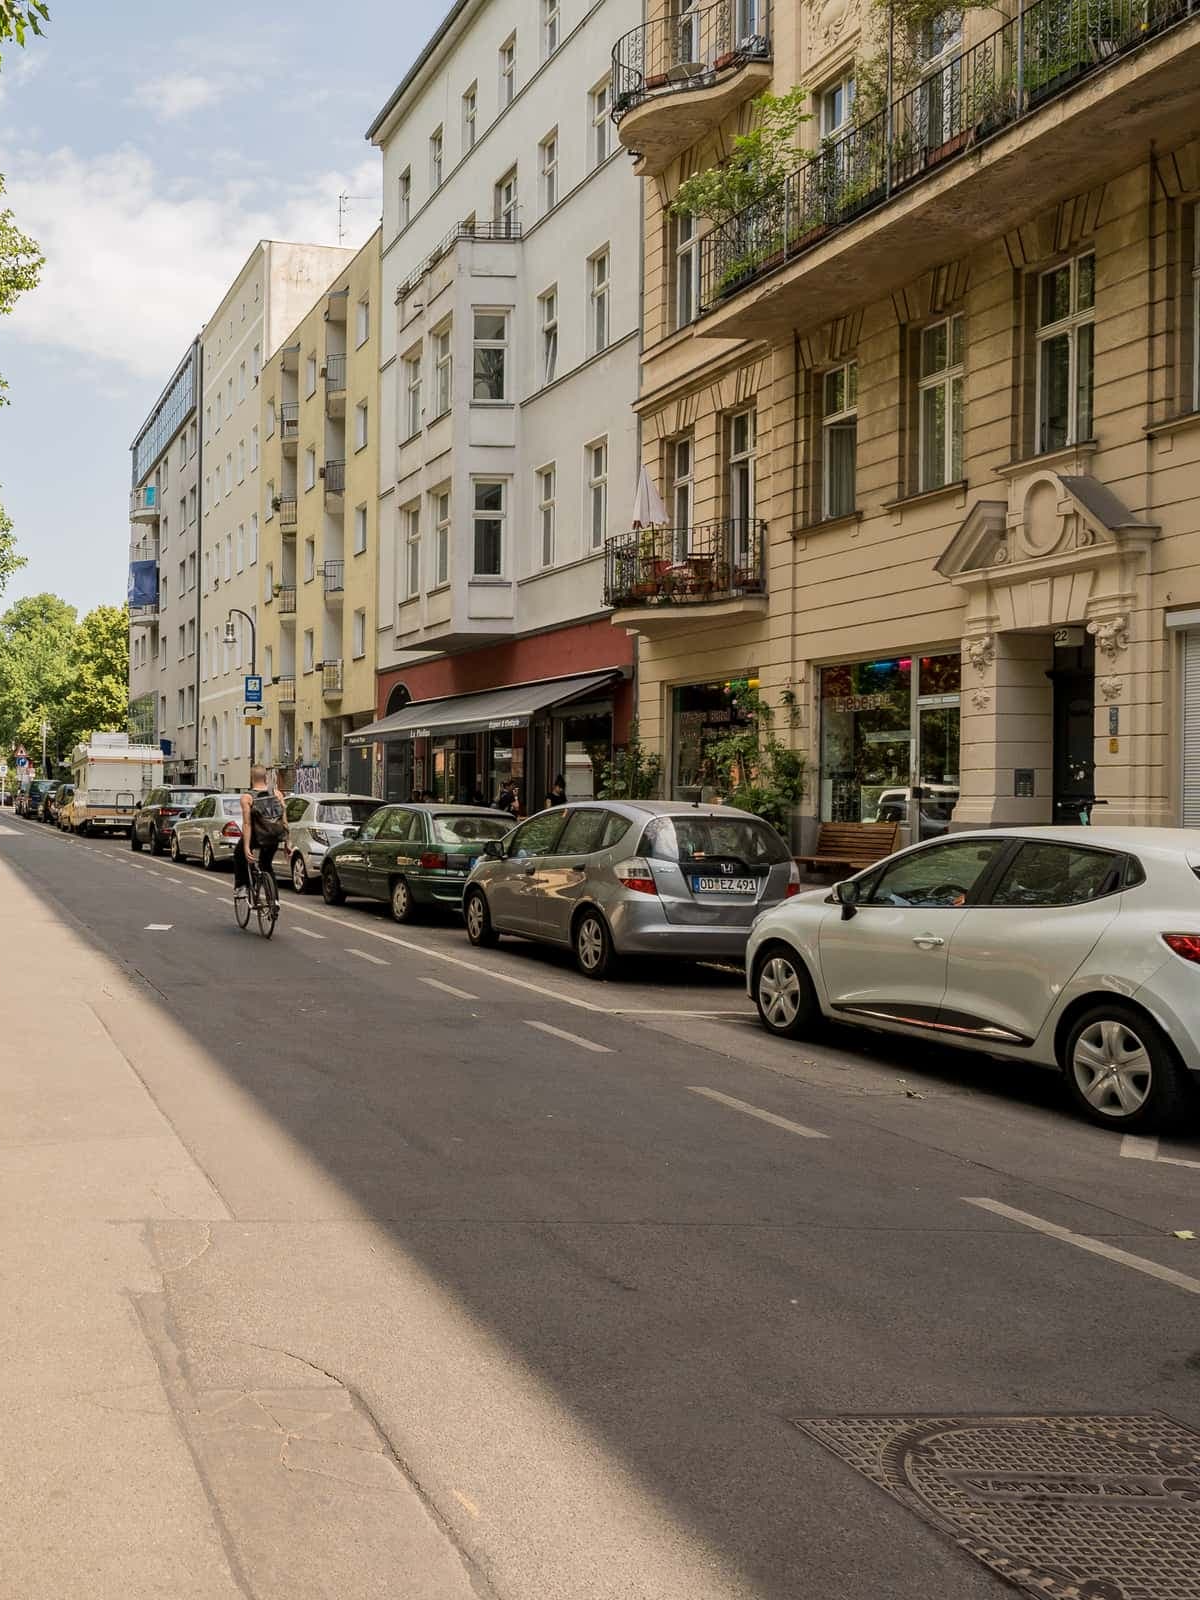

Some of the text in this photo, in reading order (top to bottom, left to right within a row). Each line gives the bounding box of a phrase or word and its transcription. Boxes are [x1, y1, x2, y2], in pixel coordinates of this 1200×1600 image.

[1055, 631, 1068, 641] 22
[720, 880, 734, 889] EZ
[736, 880, 755, 890] 491
[965, 1479, 1164, 1497] VATTENFALL
